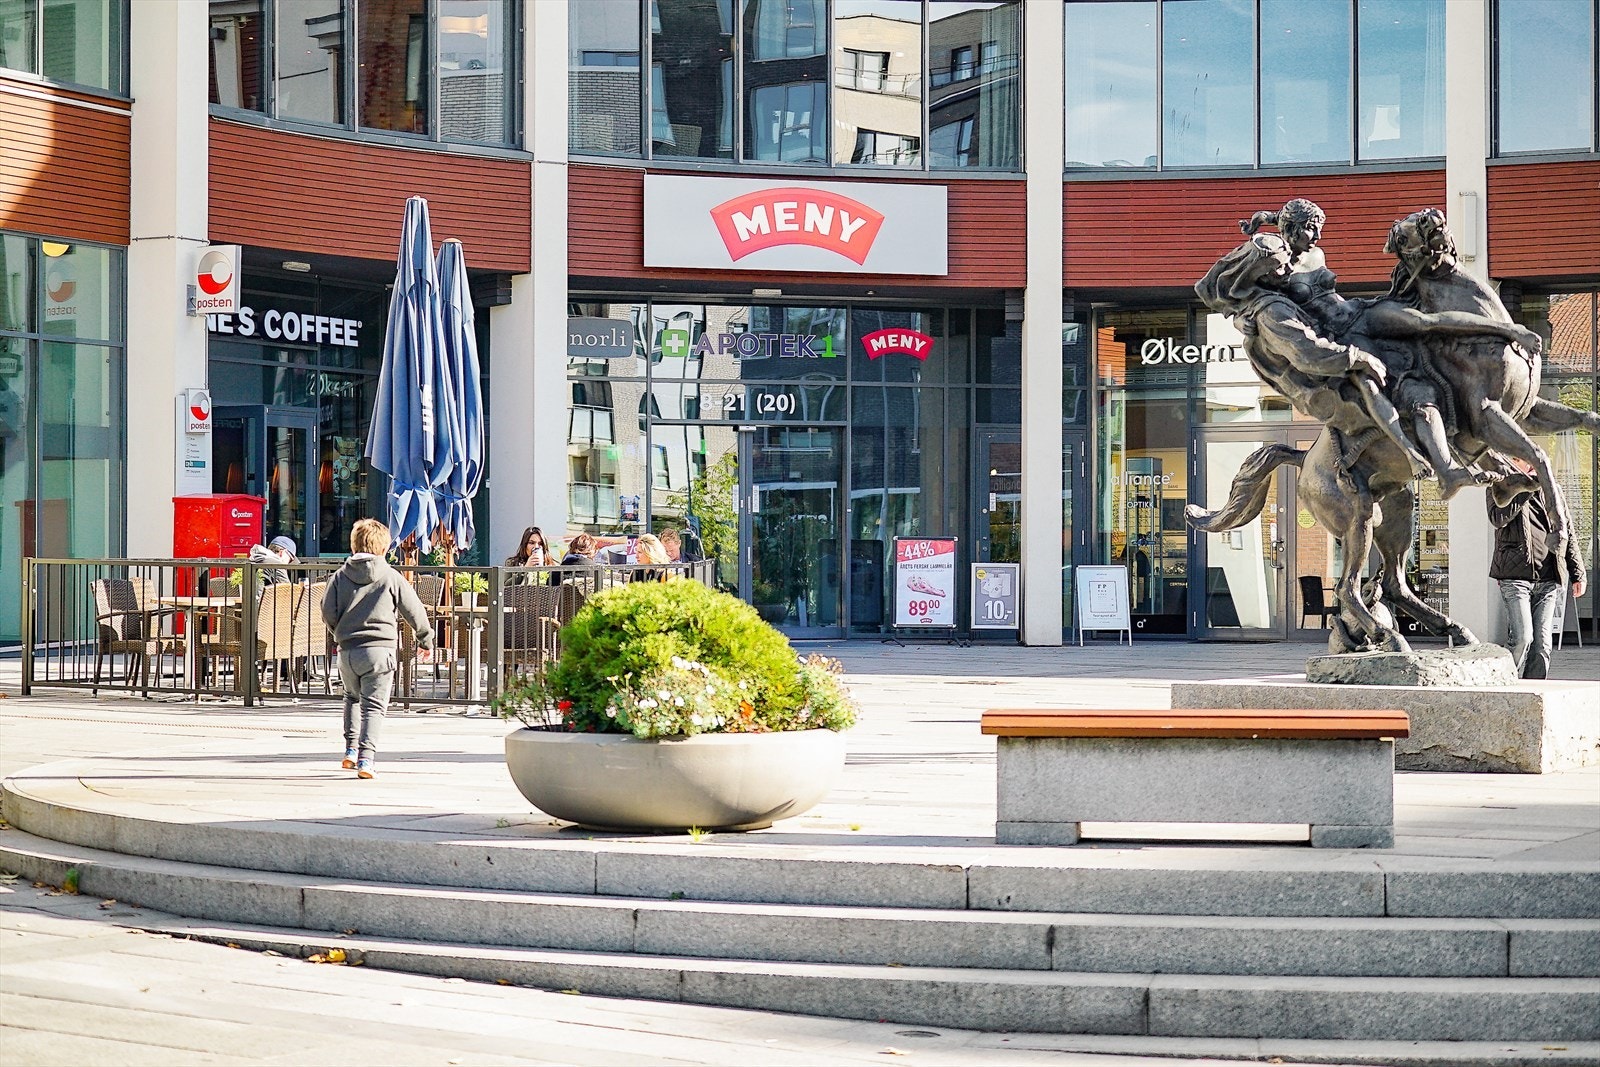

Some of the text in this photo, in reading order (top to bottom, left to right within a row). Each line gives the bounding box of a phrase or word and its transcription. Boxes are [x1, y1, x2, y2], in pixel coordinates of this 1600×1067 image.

[731, 201, 867, 243] MENY
[197, 297, 232, 309] posten
[264, 309, 359, 347] COFFEE
[569, 328, 627, 347] norli
[694, 332, 836, 359] APOTEK 1
[870, 334, 927, 352] MENY
[1141, 337, 1235, 365] Økern
[756, 393, 796, 415] (20)
[190, 422, 211, 430] posten
[898, 541, 934, 560] -44%
[984, 600, 1013, 620] 10,-
